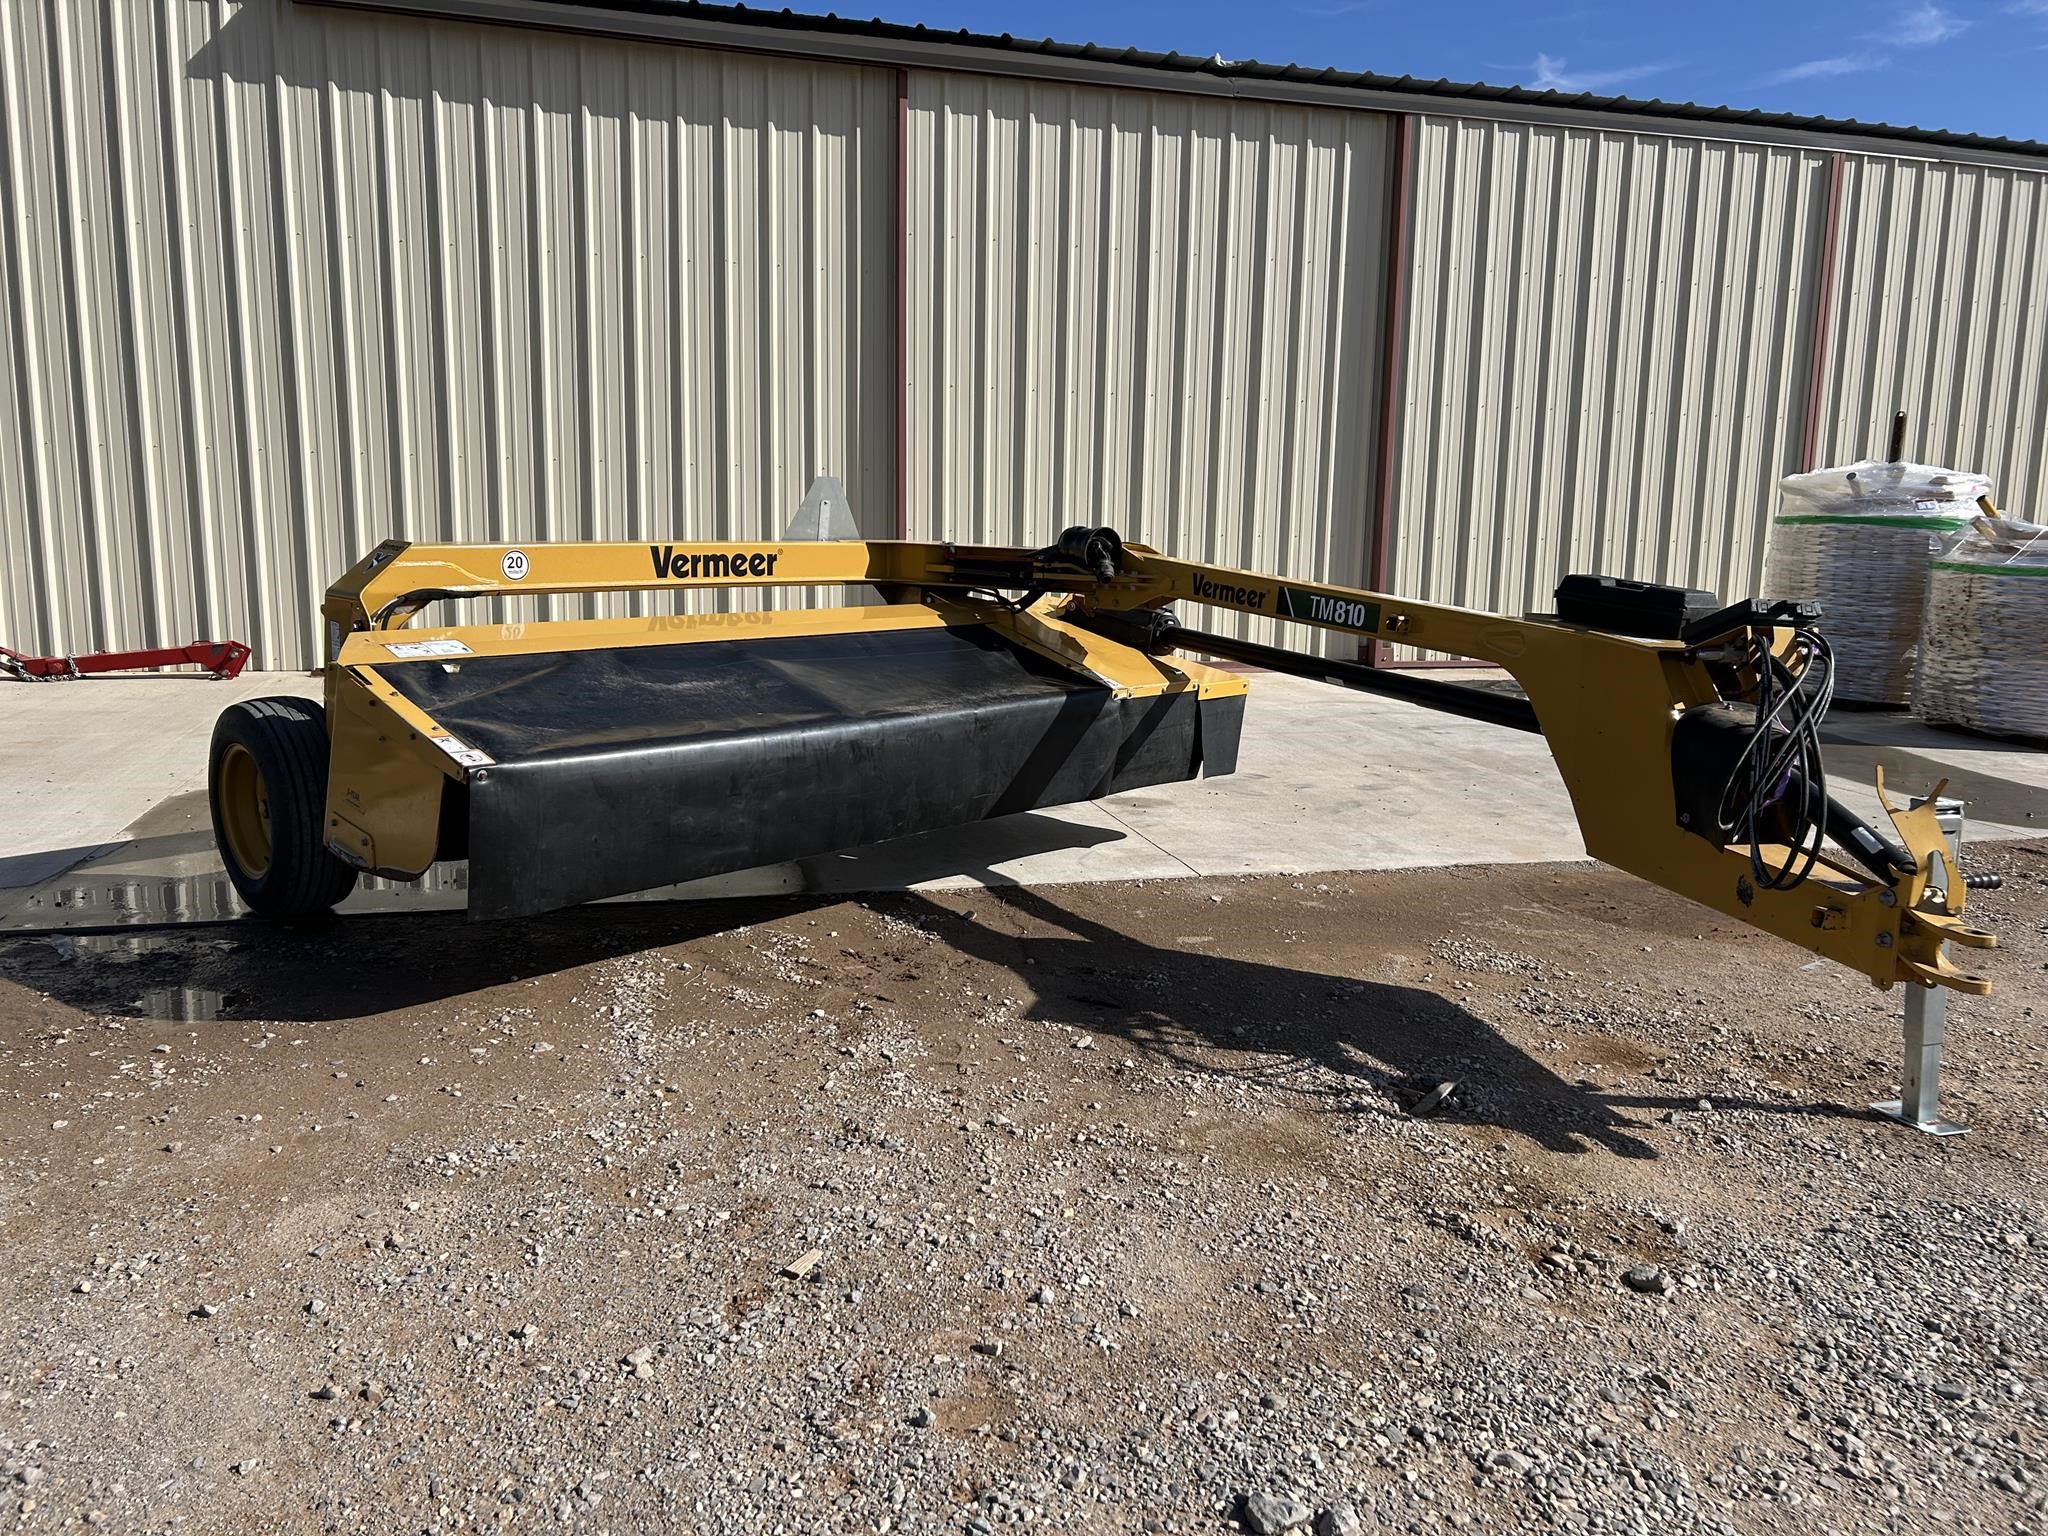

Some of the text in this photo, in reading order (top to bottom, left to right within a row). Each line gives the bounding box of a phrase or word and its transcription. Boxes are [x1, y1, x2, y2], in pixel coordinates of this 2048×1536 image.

[507, 556, 523, 569] 20
[650, 546, 778, 579] Vermeer
[1193, 572, 1266, 609] Vermeer
[1310, 595, 1366, 627] TM810
